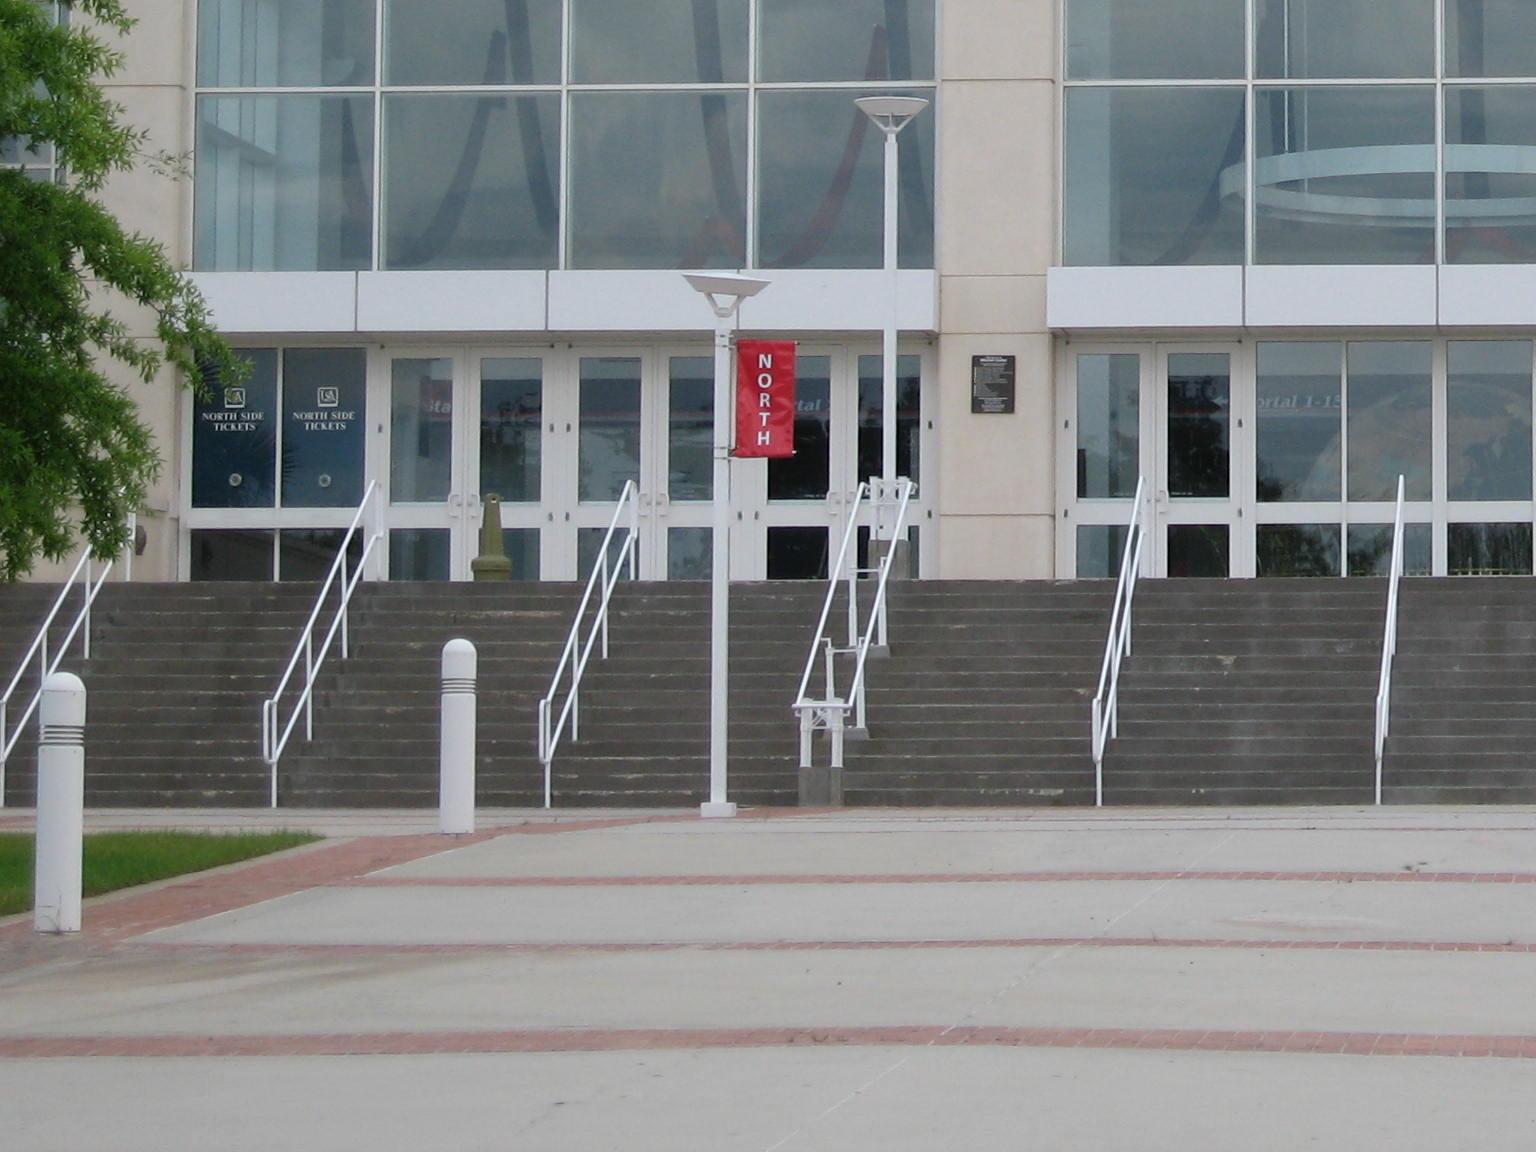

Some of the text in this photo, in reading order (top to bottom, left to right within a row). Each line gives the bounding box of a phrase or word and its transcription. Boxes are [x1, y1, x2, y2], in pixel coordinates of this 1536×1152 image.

[757, 354, 773, 446] NORTH
[1256, 394, 1297, 408] ortal
[201, 411, 265, 421] NORTH SIDE
[292, 411, 356, 421] NORTH SIDE
[213, 422, 257, 432] TICKETS
[304, 421, 347, 431] TICKETS
